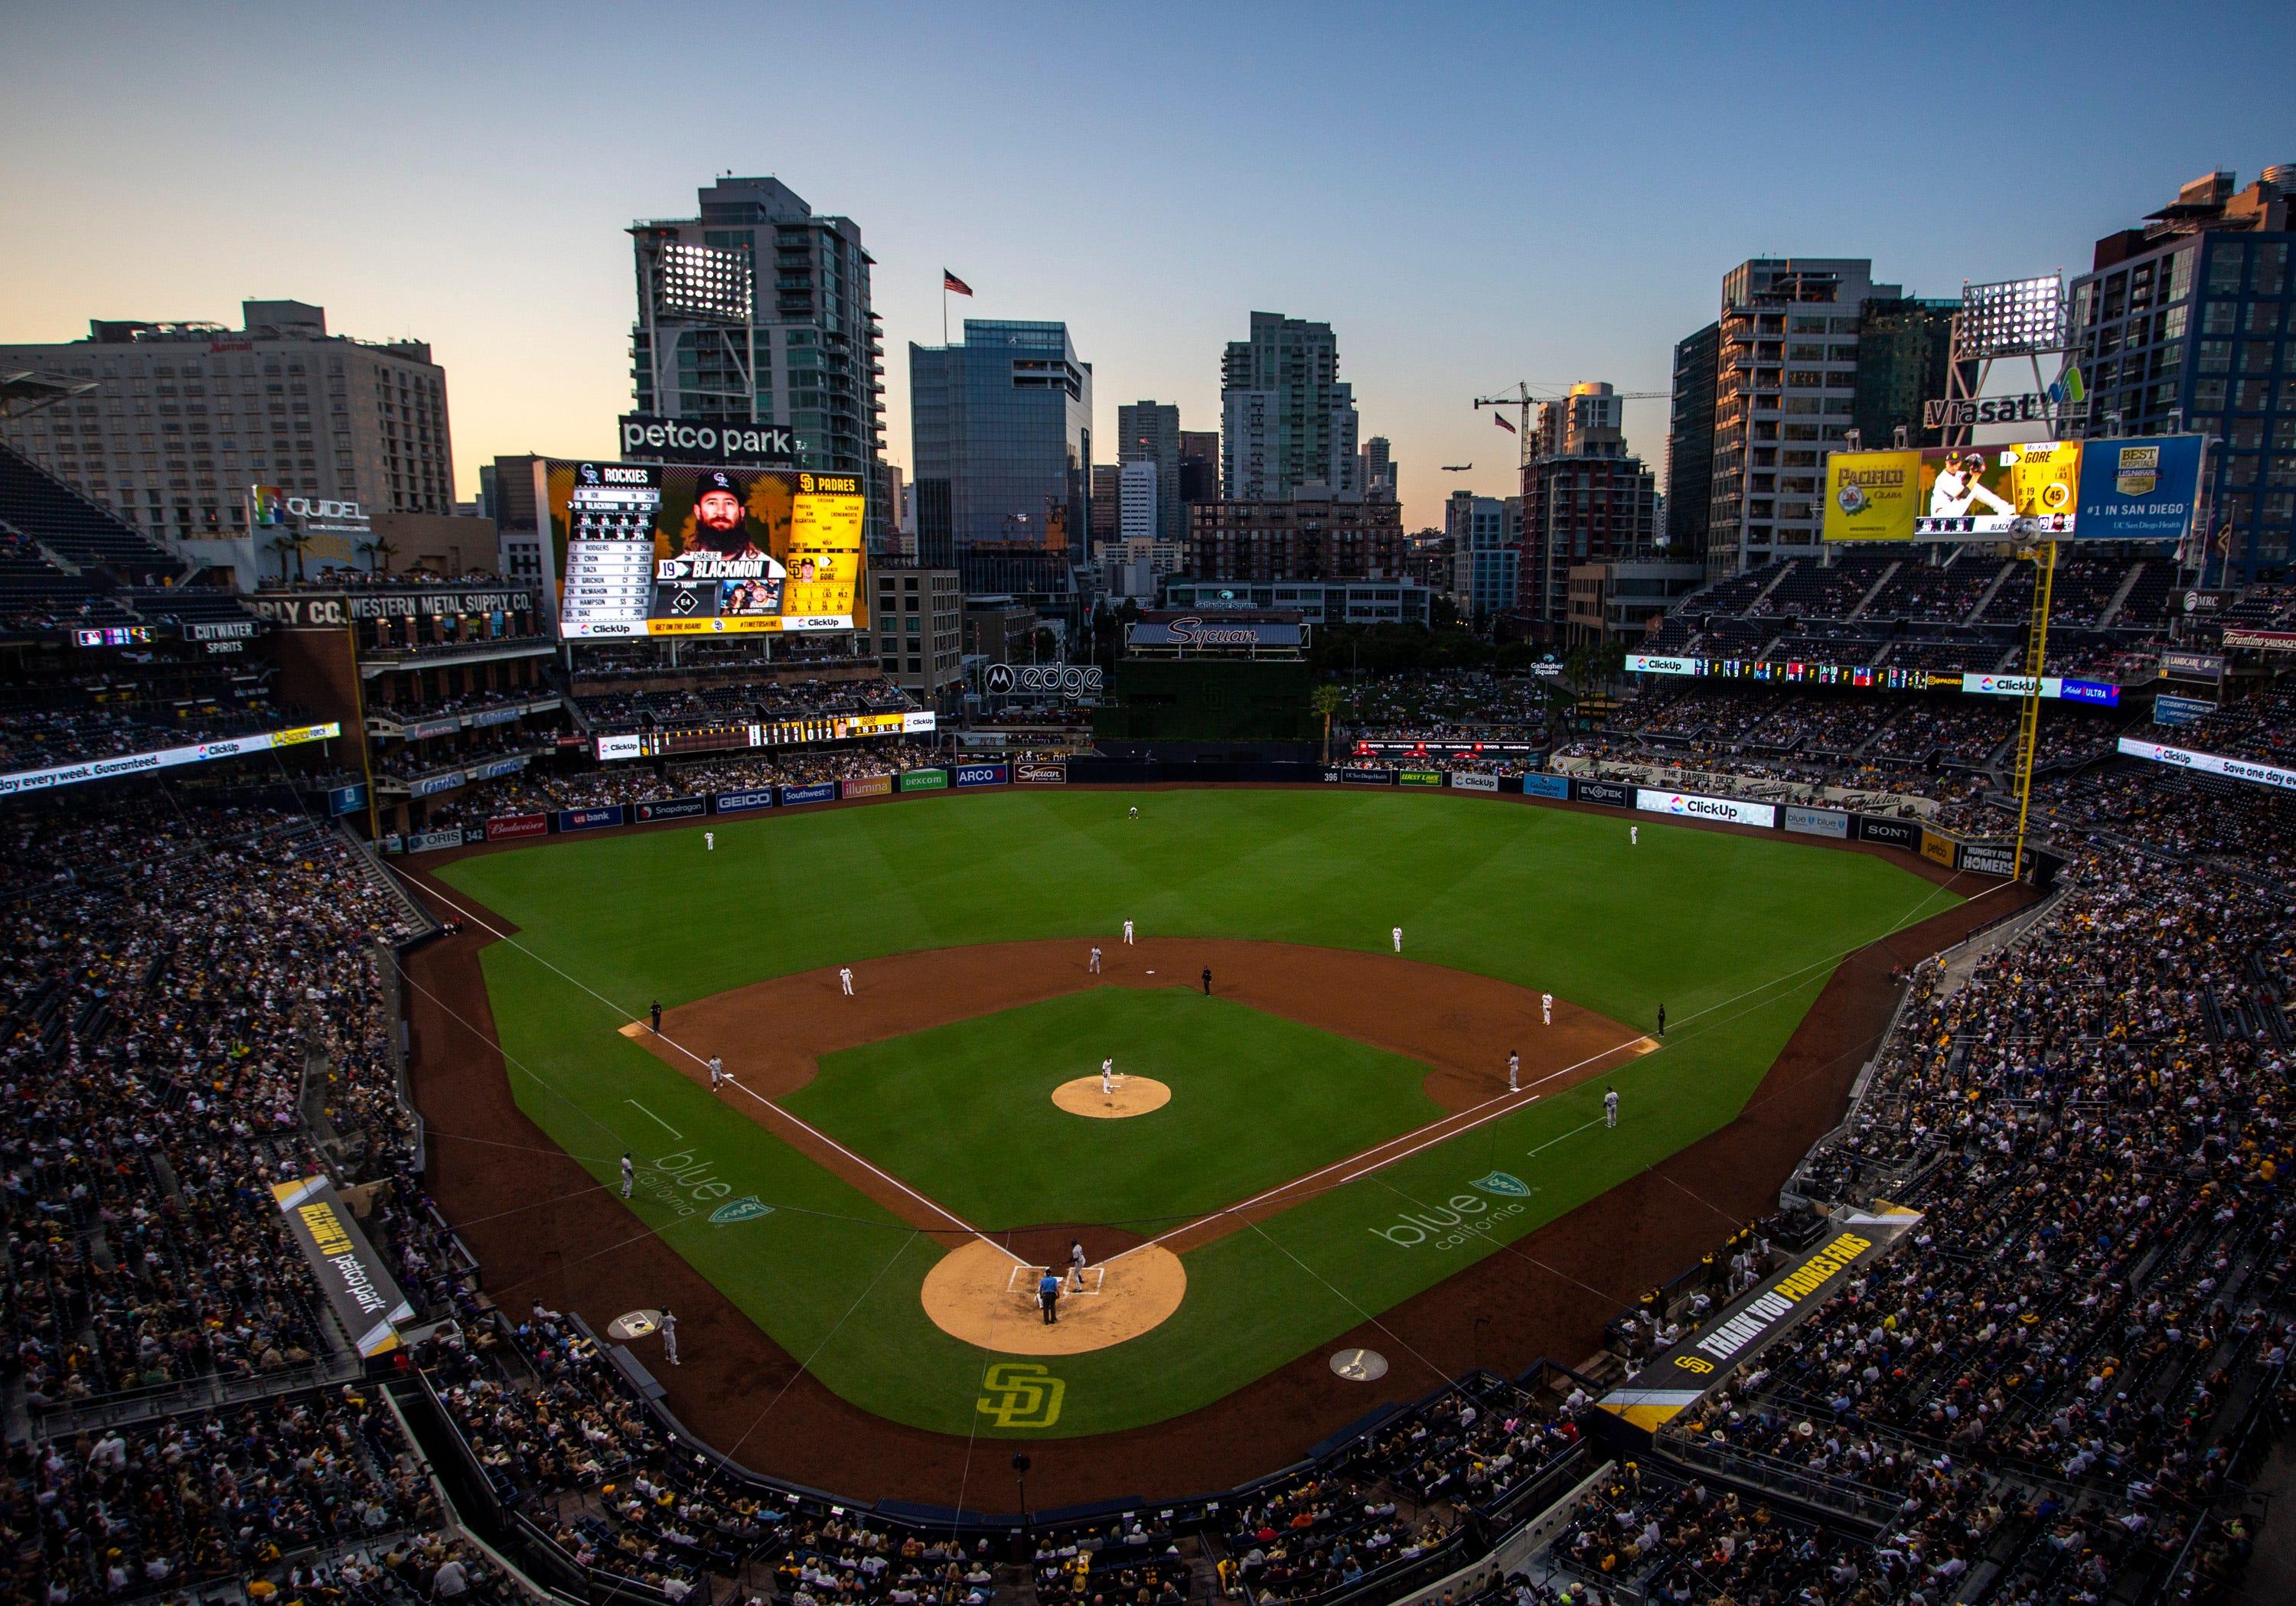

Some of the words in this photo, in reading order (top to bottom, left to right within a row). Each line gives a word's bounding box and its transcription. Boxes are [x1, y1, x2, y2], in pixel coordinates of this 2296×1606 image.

[1927, 393, 2033, 427] Viasat
[624, 420, 717, 453] petco
[722, 428, 791, 457] park
[2024, 451, 2053, 463] GORE
[2122, 448, 2157, 460] BEST
[2121, 460, 2155, 468] HOSPITALS
[604, 468, 648, 484] ROCKIES
[818, 477, 855, 492] PADRES
[2050, 490, 2060, 500] 45
[2087, 506, 2100, 516] #1
[2105, 505, 2118, 516] IN
[2121, 504, 2145, 516] SAN
[2148, 503, 2183, 515] DIEGO
[2040, 519, 2050, 529] 19
[2138, 521, 2158, 529] Diego
[693, 552, 719, 561] CHARLIE
[663, 562, 675, 577] 19
[692, 560, 764, 578] BLACKMON
[350, 596, 417, 618] WESTERN
[421, 595, 461, 614] METAL
[465, 594, 509, 613] SUPPLY
[513, 593, 532, 609] CO.
[1194, 601, 1229, 611] Gallagher
[1231, 601, 1257, 611] Square
[2197, 597, 2219, 607] MRC
[308, 601, 348, 624] CO.
[592, 625, 631, 634] ClickUp
[808, 619, 839, 627] ClickUp
[194, 624, 253, 640] CUTWATER
[1166, 617, 1260, 650] Sycuan
[2223, 631, 2264, 646] Tarantino
[207, 641, 243, 653] SPIRITS
[1649, 660, 1682, 672] ClickUp
[1714, 664, 1719, 673] F
[2170, 656, 2200, 667] LANDCARE
[1745, 666, 1750, 674] F
[1777, 667, 1782, 676] F
[1809, 669, 1815, 678] F
[1843, 671, 1849, 680] F
[1021, 662, 1104, 699] edge
[1878, 673, 1883, 682] F
[2086, 688, 2106, 699] ULTRA
[863, 716, 877, 725] GORE
[912, 718, 934, 726] ClickUp
[807, 729, 814, 741] 0
[825, 728, 833, 739] 2
[208, 742, 240, 756] ClickUp
[610, 741, 638, 753] ClickUp
[2164, 750, 2191, 765] ClickUp
[22, 774, 57, 786] every
[58, 767, 93, 780] week.
[94, 756, 160, 777] Guaranteed.
[959, 770, 993, 782] ARCO
[1018, 765, 1060, 782] Sycuan
[1324, 773, 1338, 782] 396
[1664, 769, 1678, 778] THE
[1681, 771, 1713, 783] BARREL
[1716, 776, 1737, 785] DECK
[2223, 762, 2245, 774] Save
[2246, 768, 2264, 779] one
[2265, 770, 2285, 785] day
[845, 780, 888, 796] illumina
[1465, 777, 1495, 788] ClickUp
[1531, 782, 1561, 791] Gallagher
[719, 793, 770, 809] GEICO
[786, 790, 825, 800] Southwest
[1843, 793, 1902, 810] Templeton
[586, 811, 609, 822] bank
[655, 803, 702, 816] Snapdragon
[1687, 800, 1738, 820] ClickUp
[1788, 813, 1806, 823] blue
[1817, 817, 1837, 828] blue
[488, 820, 545, 836] Budweiser
[1867, 825, 1909, 839] SONY
[427, 831, 459, 845] ORIS
[465, 829, 484, 842] 342
[1927, 843, 1947, 858] petco
[1967, 846, 1996, 858] HUNGRY
[1998, 851, 2013, 860] FOR
[1962, 855, 2014, 875] HOMERS
[653, 1148, 732, 1200] blue
[634, 1171, 698, 1217] california
[297, 1201, 348, 1245] WELCOME
[1368, 1195, 1488, 1249] blue
[1436, 1204, 1526, 1250] california
[320, 1238, 355, 1256] TO
[327, 1253, 367, 1286] petco
[345, 1283, 386, 1314] park
[1696, 1311, 1768, 1360] THANK
[1745, 1291, 1794, 1323] YOU
[1774, 1255, 1842, 1302] PADRES
[1821, 1232, 1872, 1265] FANS
